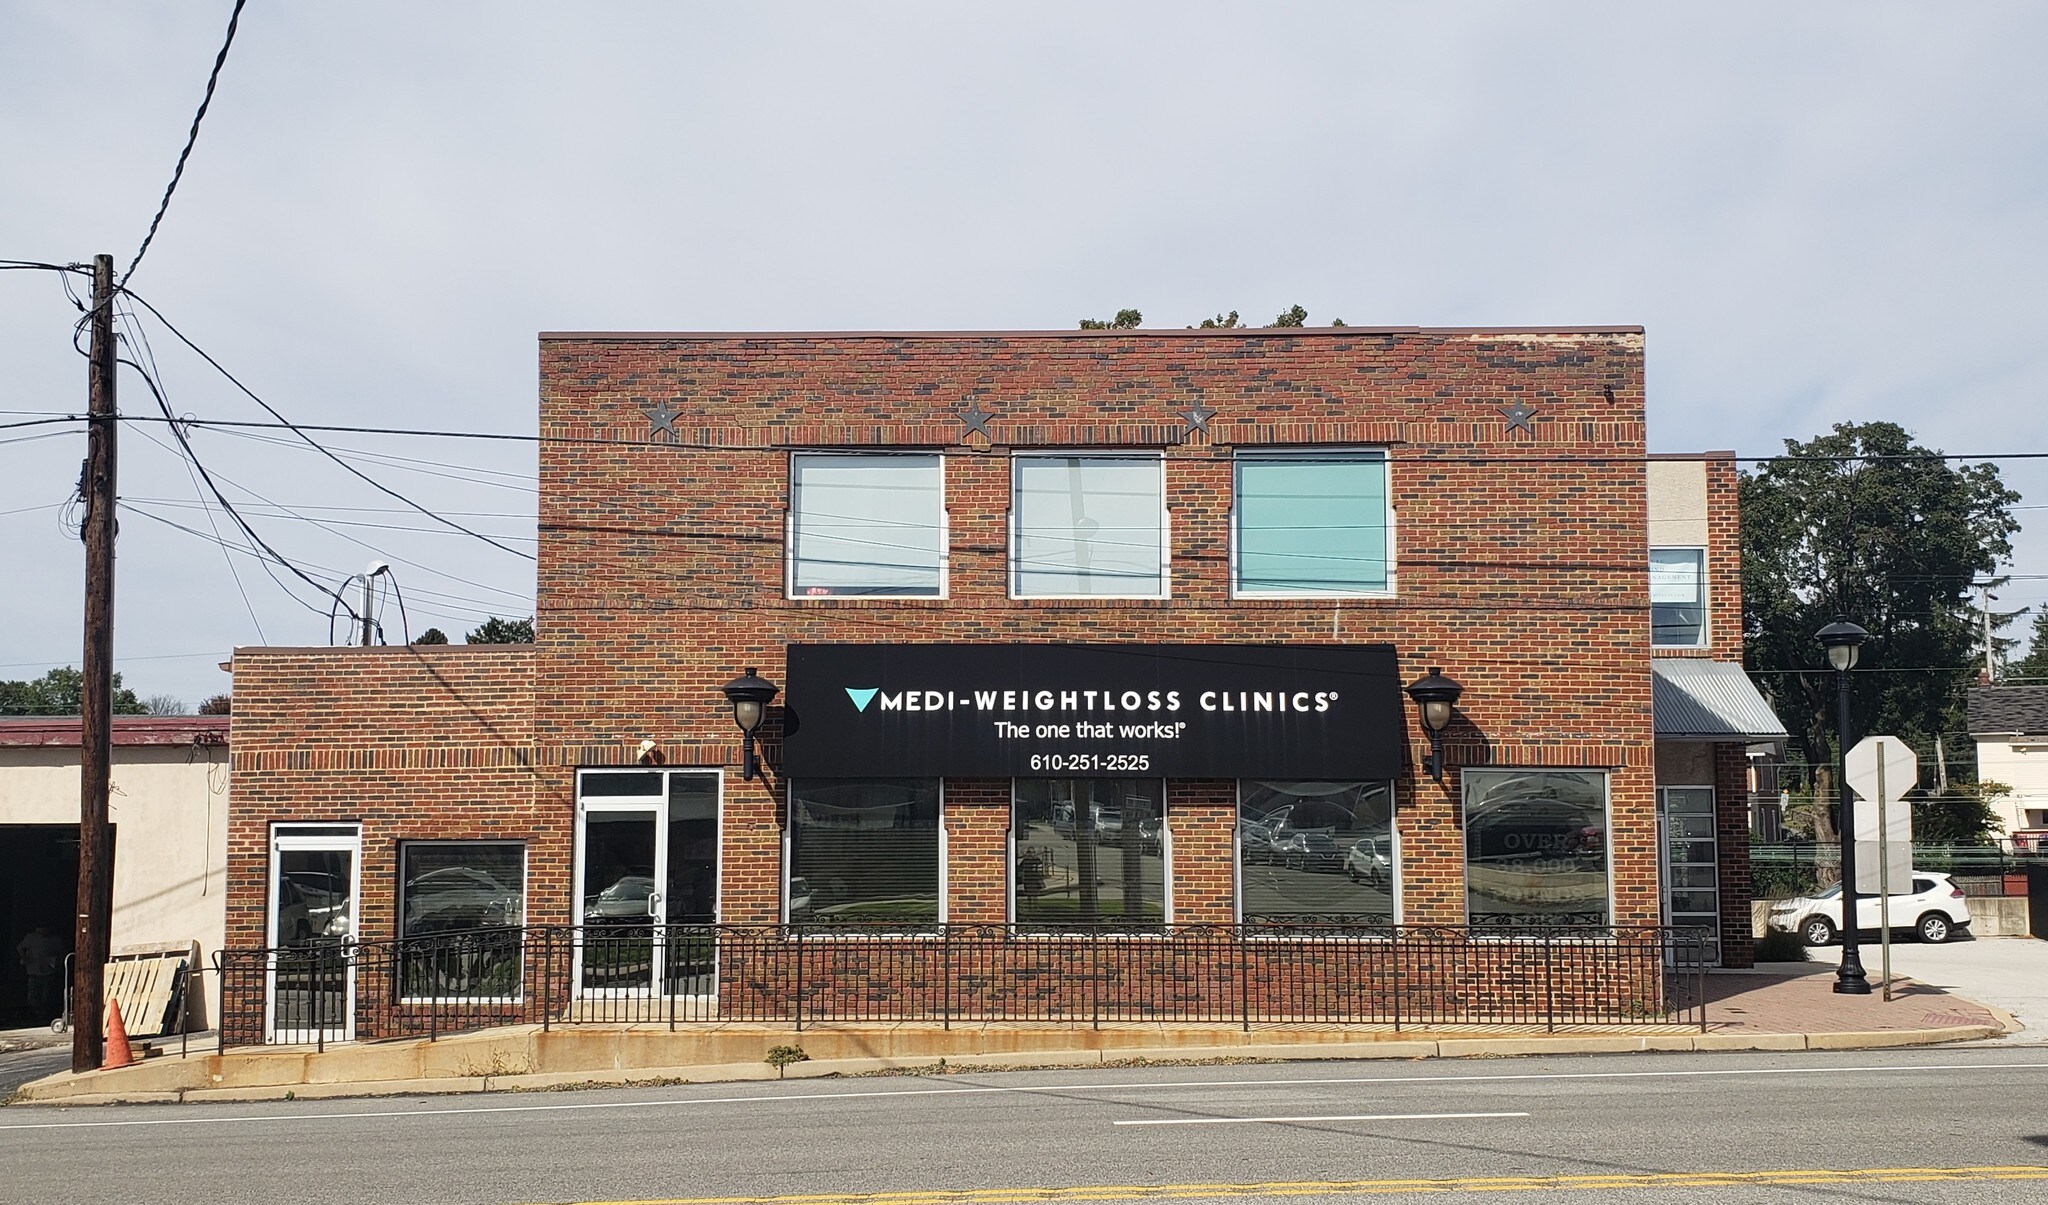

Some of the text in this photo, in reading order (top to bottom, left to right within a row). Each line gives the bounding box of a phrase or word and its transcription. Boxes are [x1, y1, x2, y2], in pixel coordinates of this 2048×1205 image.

[880, 690, 1181, 712] MEDI-WEIGHTLOSS
[993, 721, 1030, 738] The
[1035, 724, 1071, 739] one
[1075, 721, 1113, 738] that
[1030, 754, 1150, 771] 610-251-2525
[1503, 833, 1569, 849] OVER
